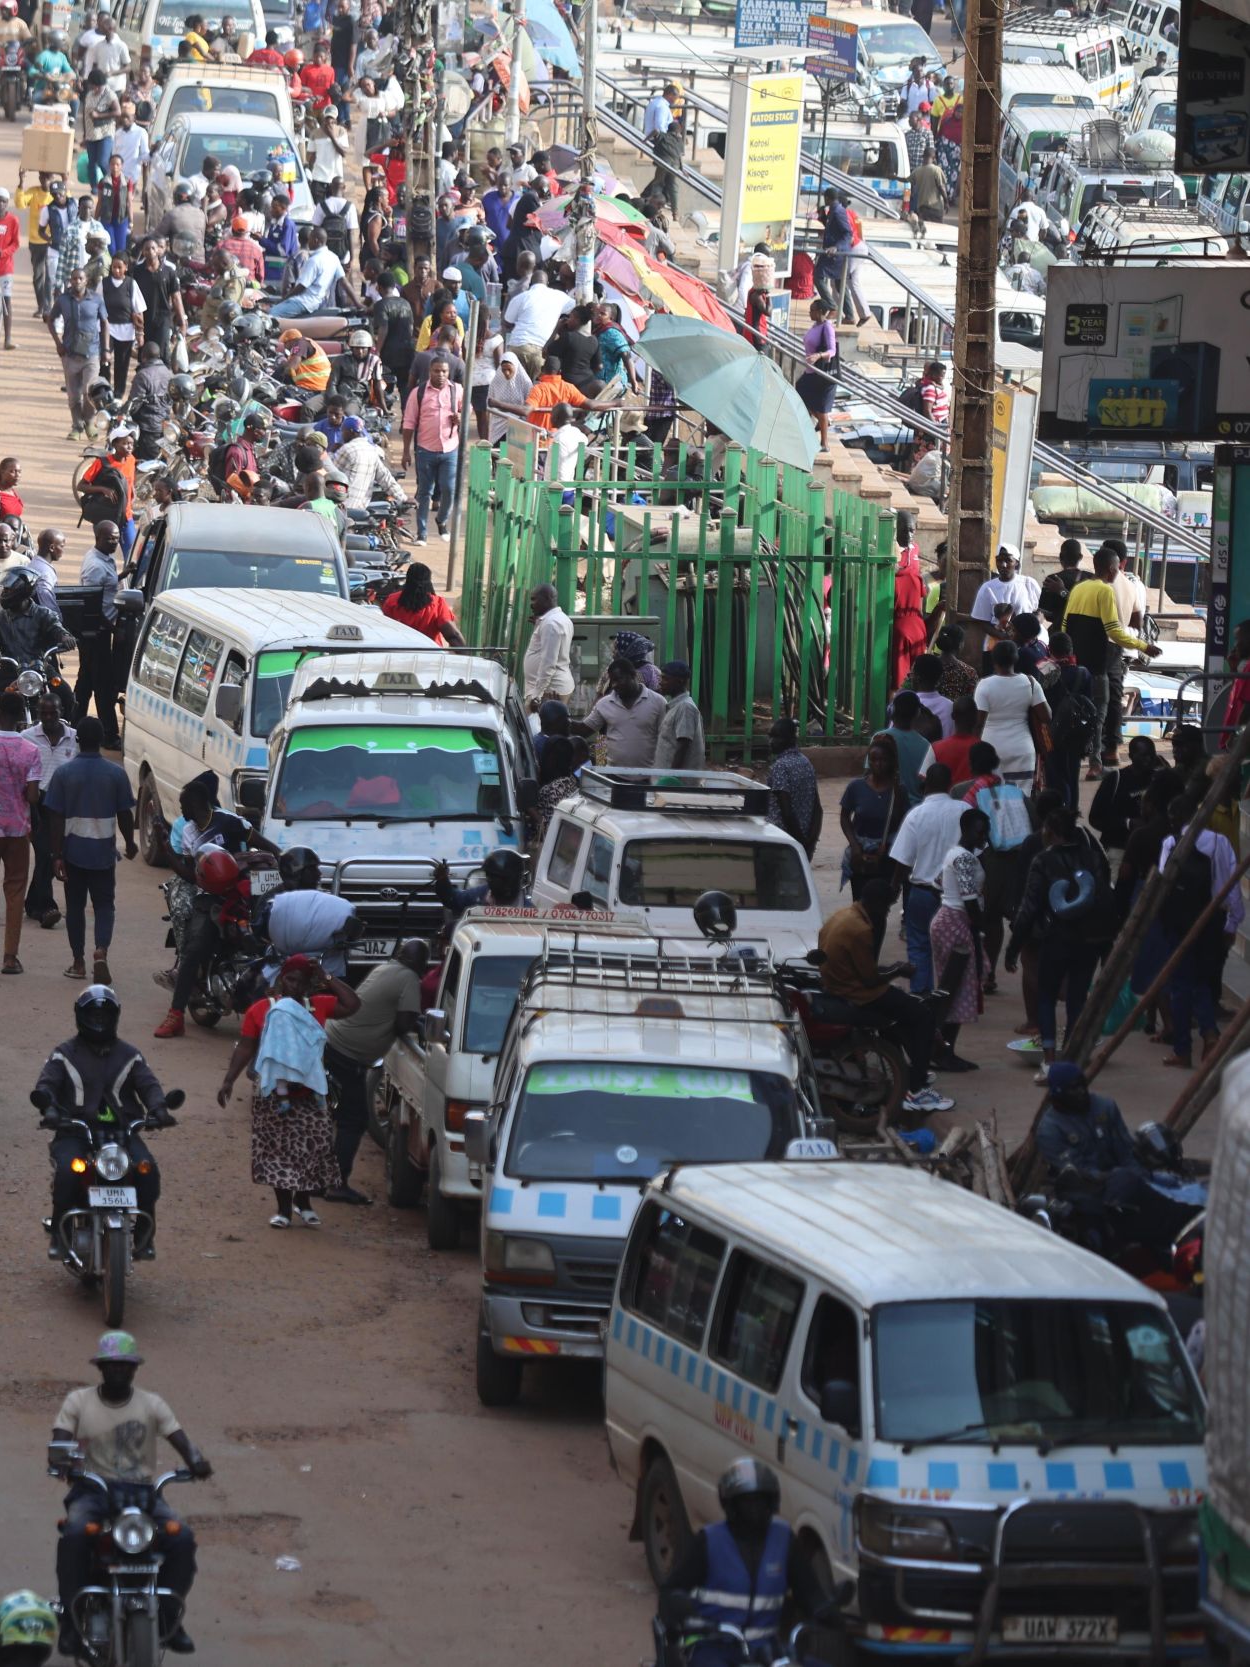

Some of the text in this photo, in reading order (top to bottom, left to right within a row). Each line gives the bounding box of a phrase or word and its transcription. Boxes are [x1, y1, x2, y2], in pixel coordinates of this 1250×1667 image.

[752, 112, 794, 123] KATOSI STAGE
[1066, 316, 1081, 336] 3
[335, 626, 359, 636] TAXI
[1214, 616, 1225, 646] SPJ
[383, 673, 412, 685] TAXI
[551, 910, 615, 921] 0704770317
[540, 1067, 662, 1089] TRUST
[797, 1143, 832, 1156] TAXI
[1024, 1617, 1110, 1639] UAW 372X
